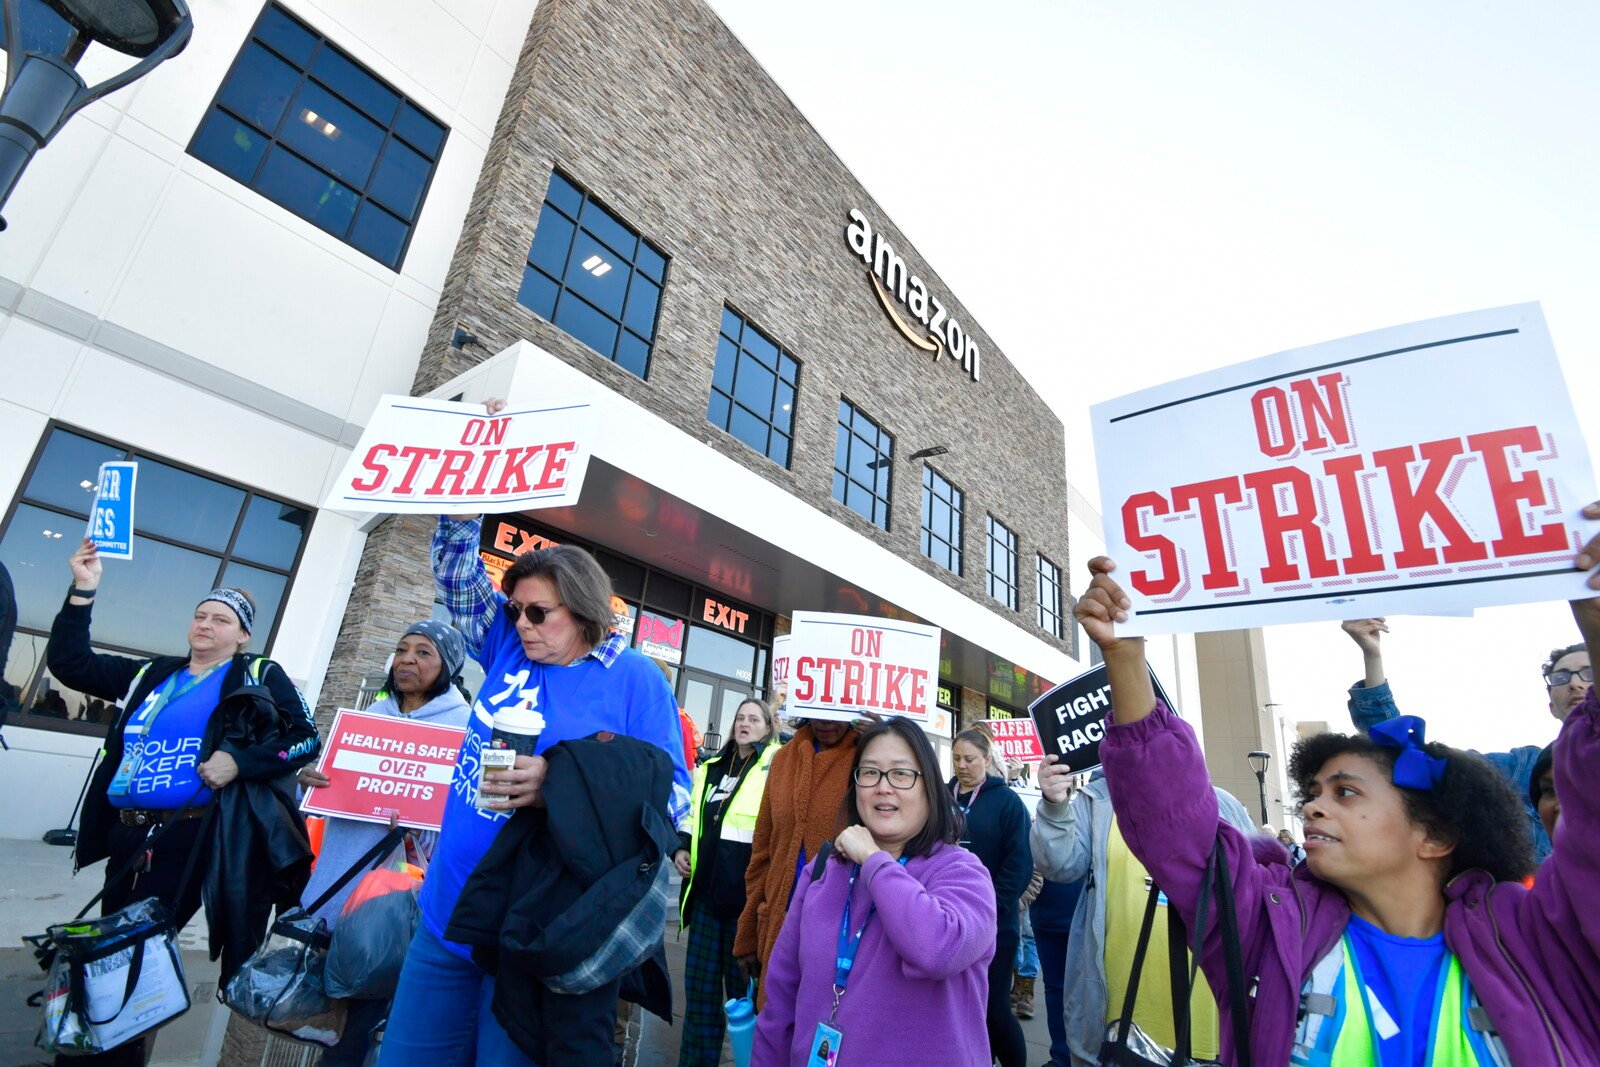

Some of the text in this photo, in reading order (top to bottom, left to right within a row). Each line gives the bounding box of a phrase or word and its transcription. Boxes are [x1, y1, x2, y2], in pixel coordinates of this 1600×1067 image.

[846, 208, 980, 382] amazon
[1251, 372, 1352, 457] ON
[460, 417, 512, 446] ON
[351, 441, 576, 495] STRIKE
[1122, 425, 1571, 597] STRIKE
[94, 540, 127, 550] COMMITTEE
[703, 598, 749, 633] EXIT
[851, 628, 883, 658] ON
[795, 656, 928, 714] STRIKE
[991, 721, 1034, 737] SAFER
[340, 732, 404, 753] HEALTH
[404, 742, 415, 755] &
[417, 743, 460, 761] SAFE
[378, 758, 427, 778] OVER
[356, 776, 434, 800] PROFITS
